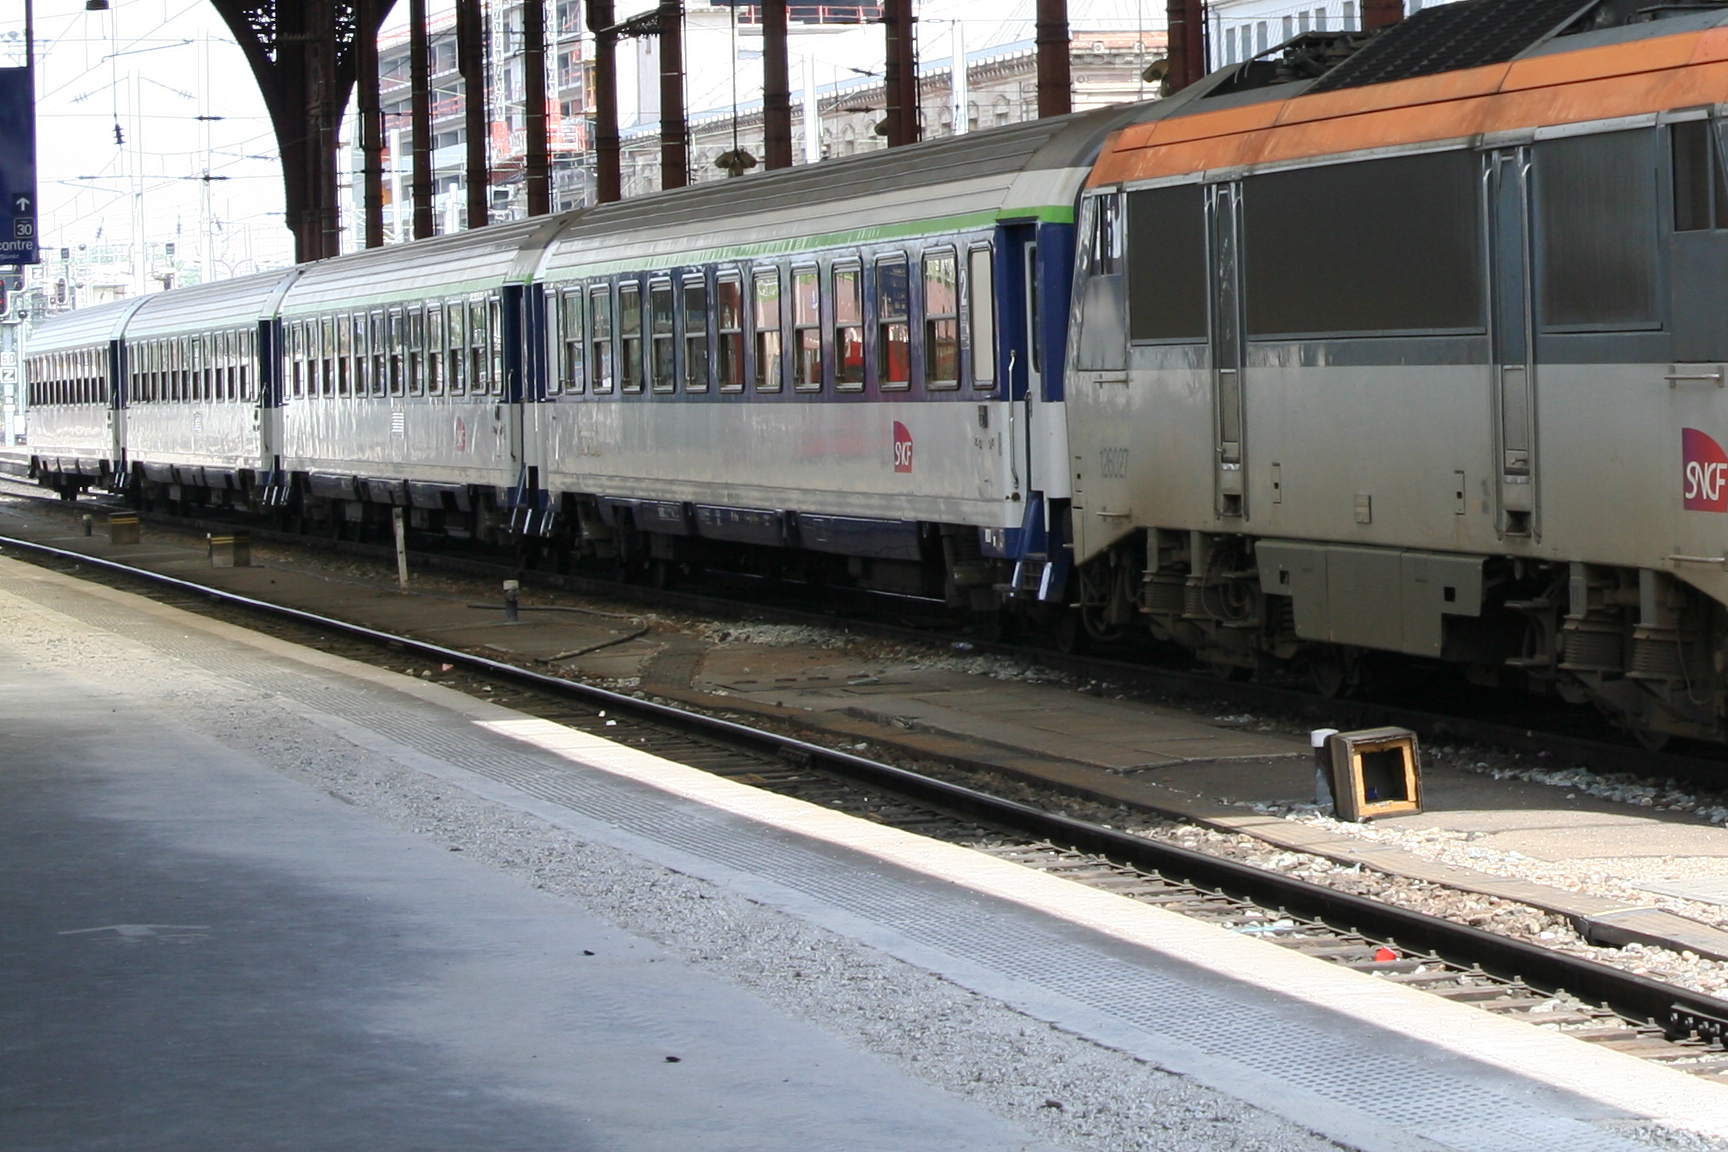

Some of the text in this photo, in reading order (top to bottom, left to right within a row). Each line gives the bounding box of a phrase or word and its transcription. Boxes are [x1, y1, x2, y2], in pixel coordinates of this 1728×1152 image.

[16, 223, 33, 236] 30
[960, 269, 967, 306] 2
[3, 369, 15, 381] Z
[1684, 460, 1728, 501] SNCF
